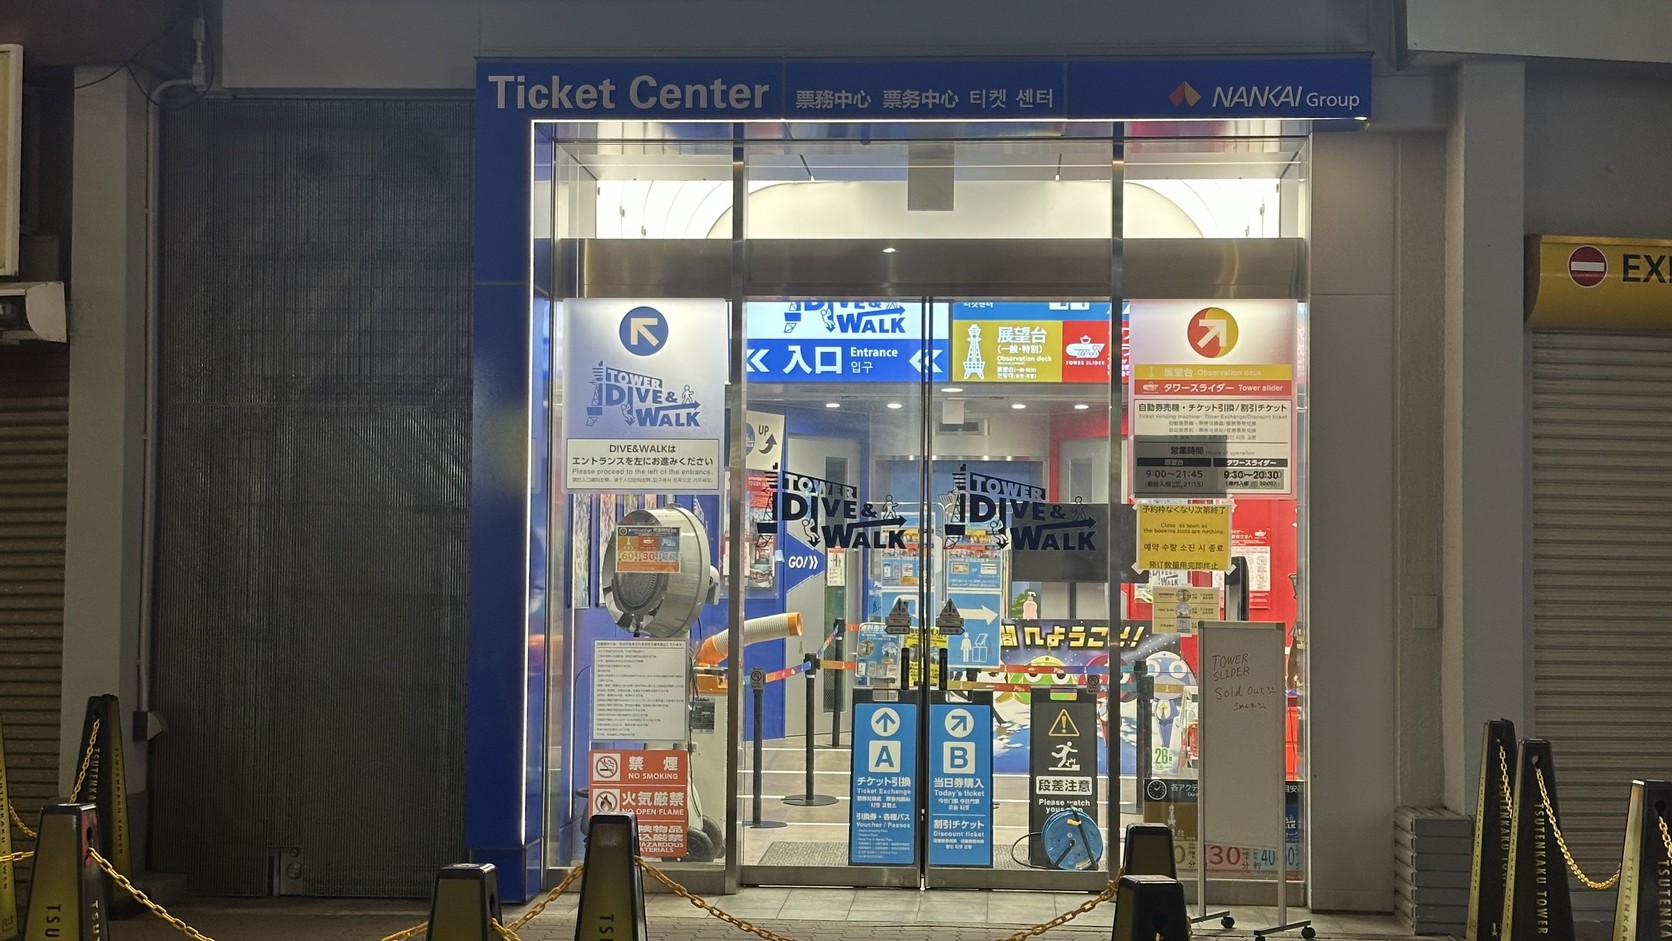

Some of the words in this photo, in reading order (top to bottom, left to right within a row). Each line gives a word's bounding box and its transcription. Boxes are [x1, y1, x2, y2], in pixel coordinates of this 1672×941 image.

[488, 75, 616, 109] Ticket
[629, 75, 769, 109] Center
[796, 90, 872, 109] 票務中心
[883, 90, 959, 109] 票务中心
[970, 89, 1007, 109] 티켓
[1016, 89, 1053, 109] 센터
[1212, 86, 1302, 107] NANKAI
[1306, 93, 1360, 110] Group
[836, 313, 906, 333] WALK
[998, 326, 1048, 343] 展望台
[783, 345, 843, 374] 入口
[850, 347, 898, 358] Entrance
[851, 361, 874, 374] 입구
[1164, 368, 1193, 377] 展望台
[607, 368, 662, 389] TOWER
[1164, 384, 1235, 392] タワースライダー
[635, 407, 700, 427] WALK
[758, 425, 769, 435] UP
[609, 444, 676, 453] DIVE&WALKは
[1170, 446, 1204, 454] 営業時間
[572, 457, 714, 466] エントランスを左にお進みください
[784, 474, 856, 498] TOWER
[972, 475, 1043, 500] TOWER
[1142, 506, 1226, 514] 予約枠なくなり次第終了
[821, 524, 906, 549] WALK
[1010, 525, 1096, 550] WALK
[1144, 543, 1160, 552] 예약
[1162, 543, 1178, 552] 수량
[1180, 543, 1195, 552] 소진
[1198, 543, 1206, 552] 시
[1208, 544, 1224, 552] 종료
[788, 556, 808, 569] GO!
[1212, 653, 1248, 670] TOWER
[1213, 666, 1250, 681] SLIDER
[1215, 686, 1243, 700] Sold
[874, 745, 894, 768] A
[950, 747, 968, 768] B
[857, 777, 911, 788] チケット引換
[934, 778, 984, 788] 当日券購入
[1038, 779, 1090, 792] 段差注意
[622, 791, 684, 806] 火気厳禁
[934, 789, 962, 797] Today's
[1038, 798, 1064, 806] Please
[659, 808, 684, 816] FLAME
[638, 825, 683, 833] 険物品
[933, 820, 985, 830] 割引チケット
[1533, 803, 1548, 884] TSUTENKAKU
[1209, 846, 1241, 866] 30
[1536, 891, 1549, 934] TOWER
